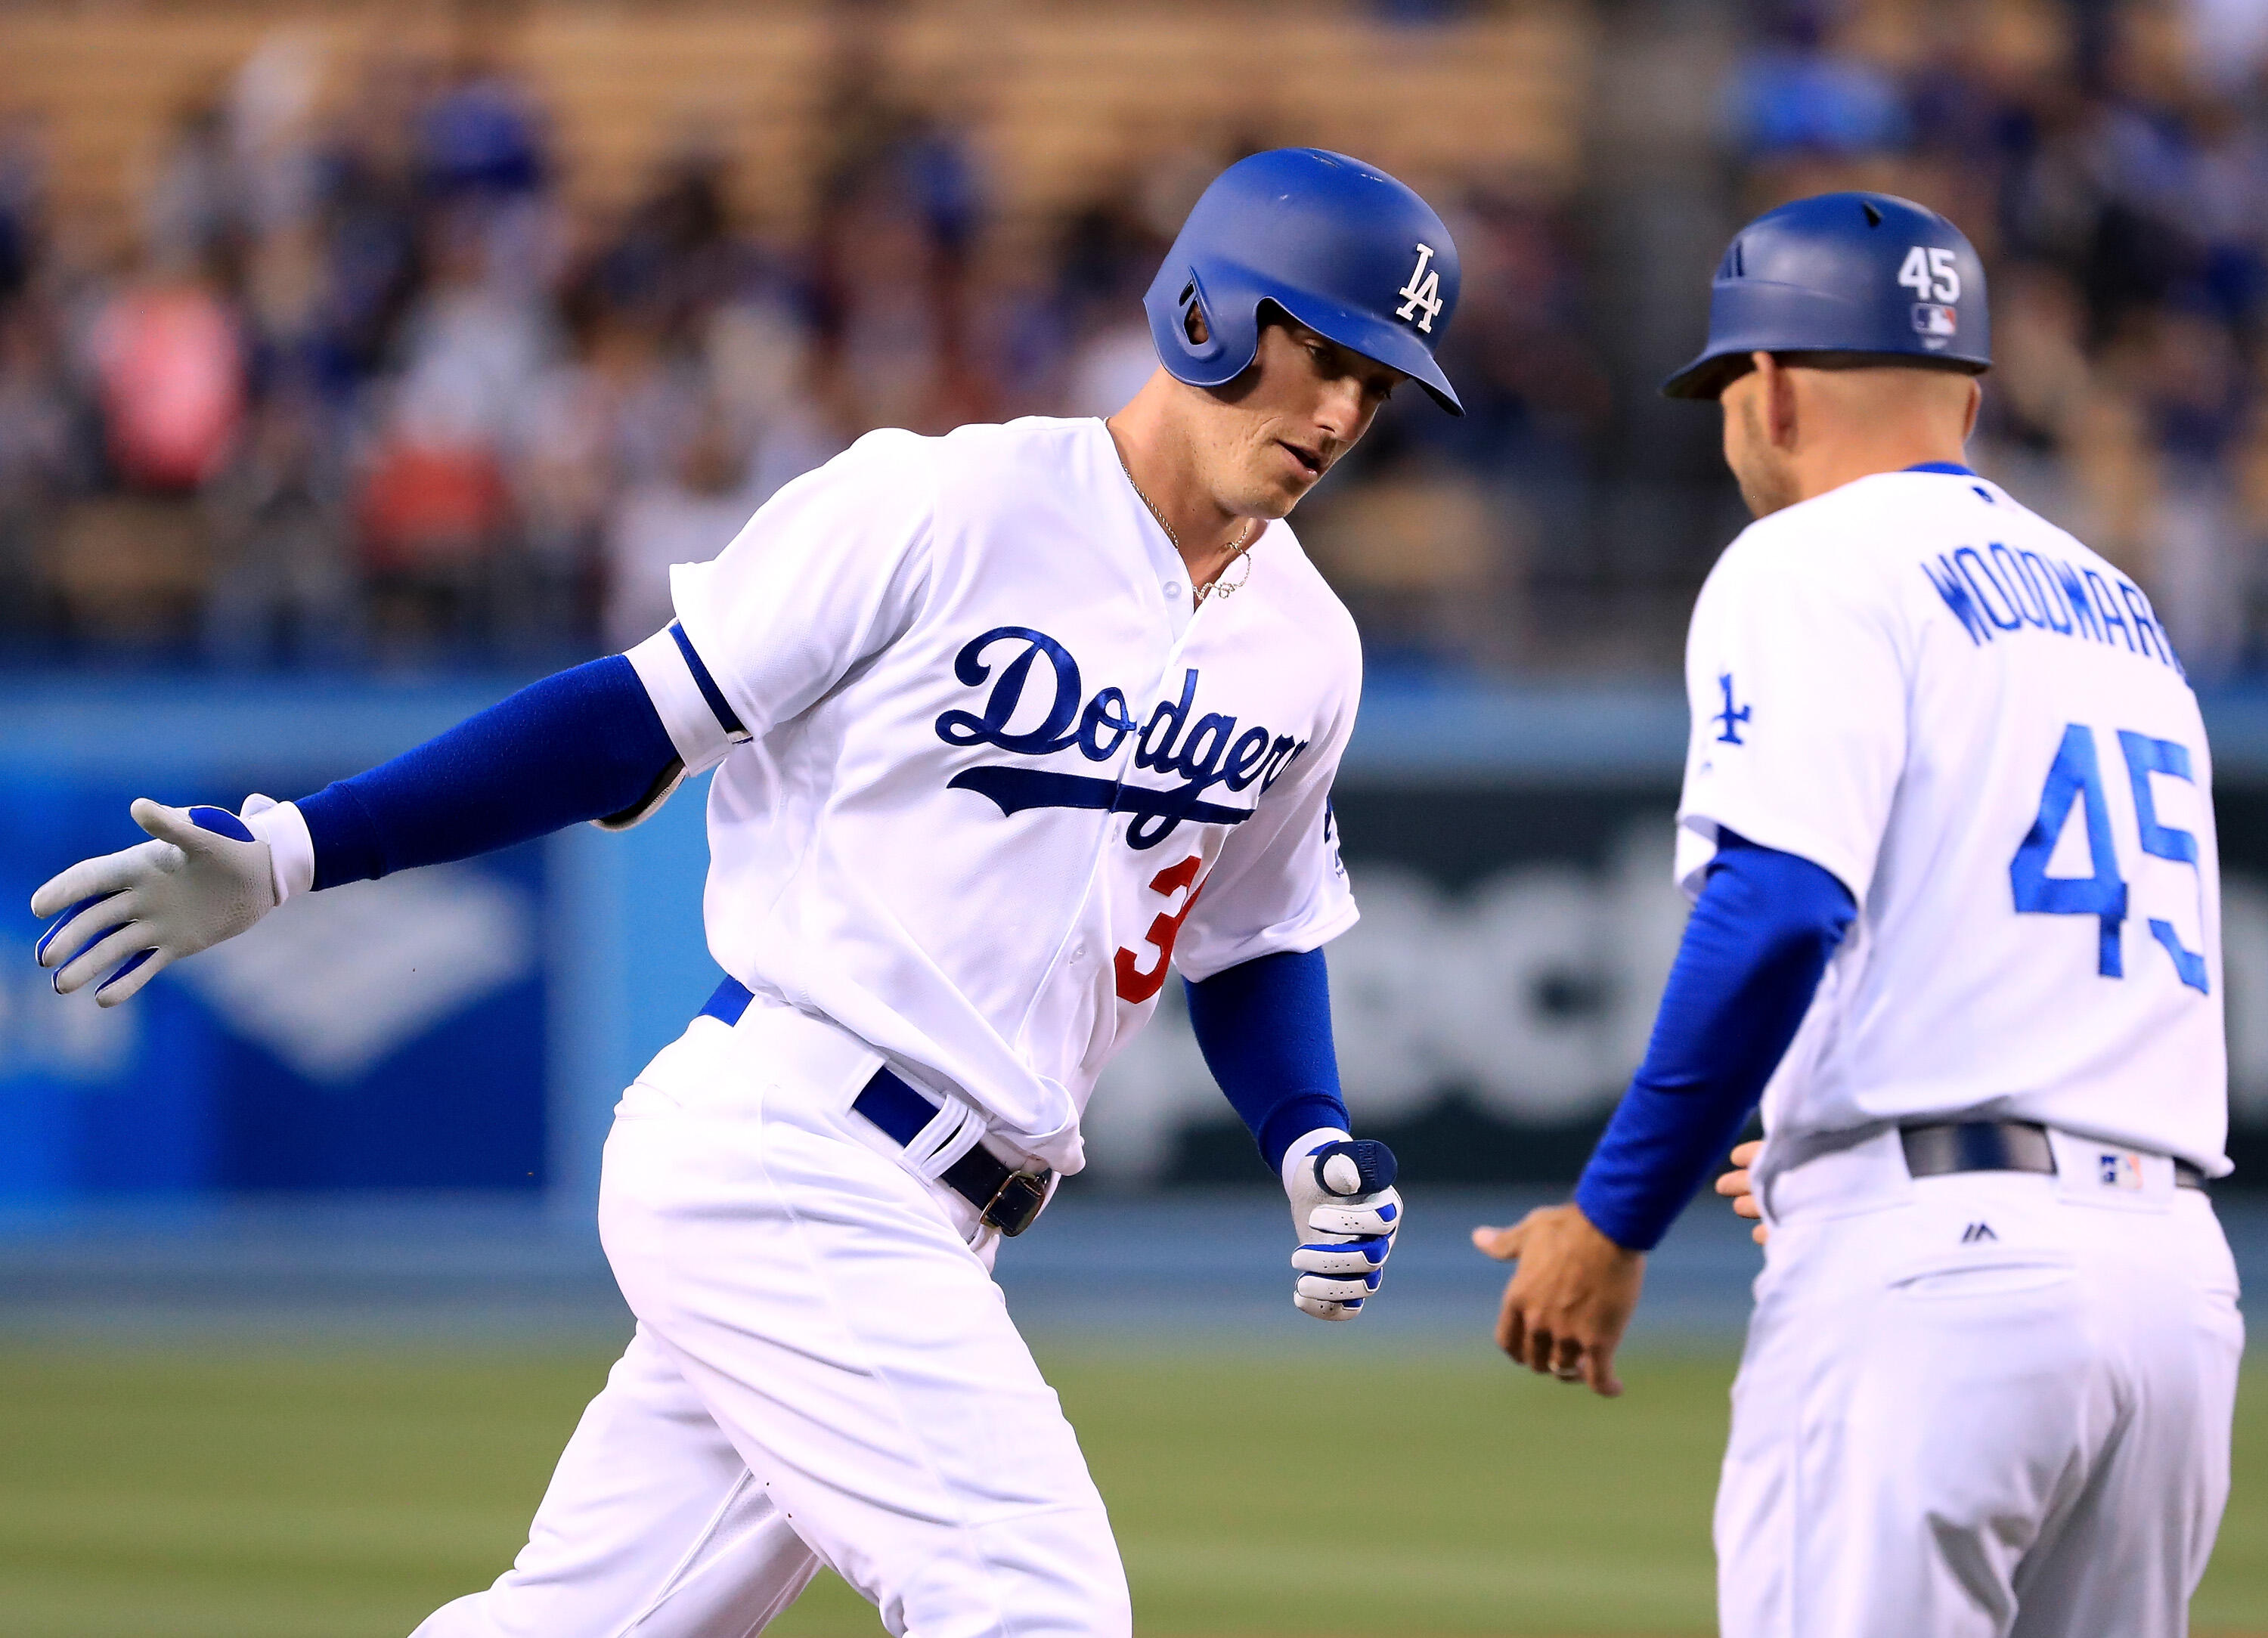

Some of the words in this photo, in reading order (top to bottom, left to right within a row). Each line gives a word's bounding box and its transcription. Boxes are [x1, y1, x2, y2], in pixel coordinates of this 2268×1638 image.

[1396, 243, 1443, 334] LA
[1898, 246, 1961, 304] 45
[1920, 542, 2188, 677] WOODWAR
[2008, 722, 2210, 996] 45
